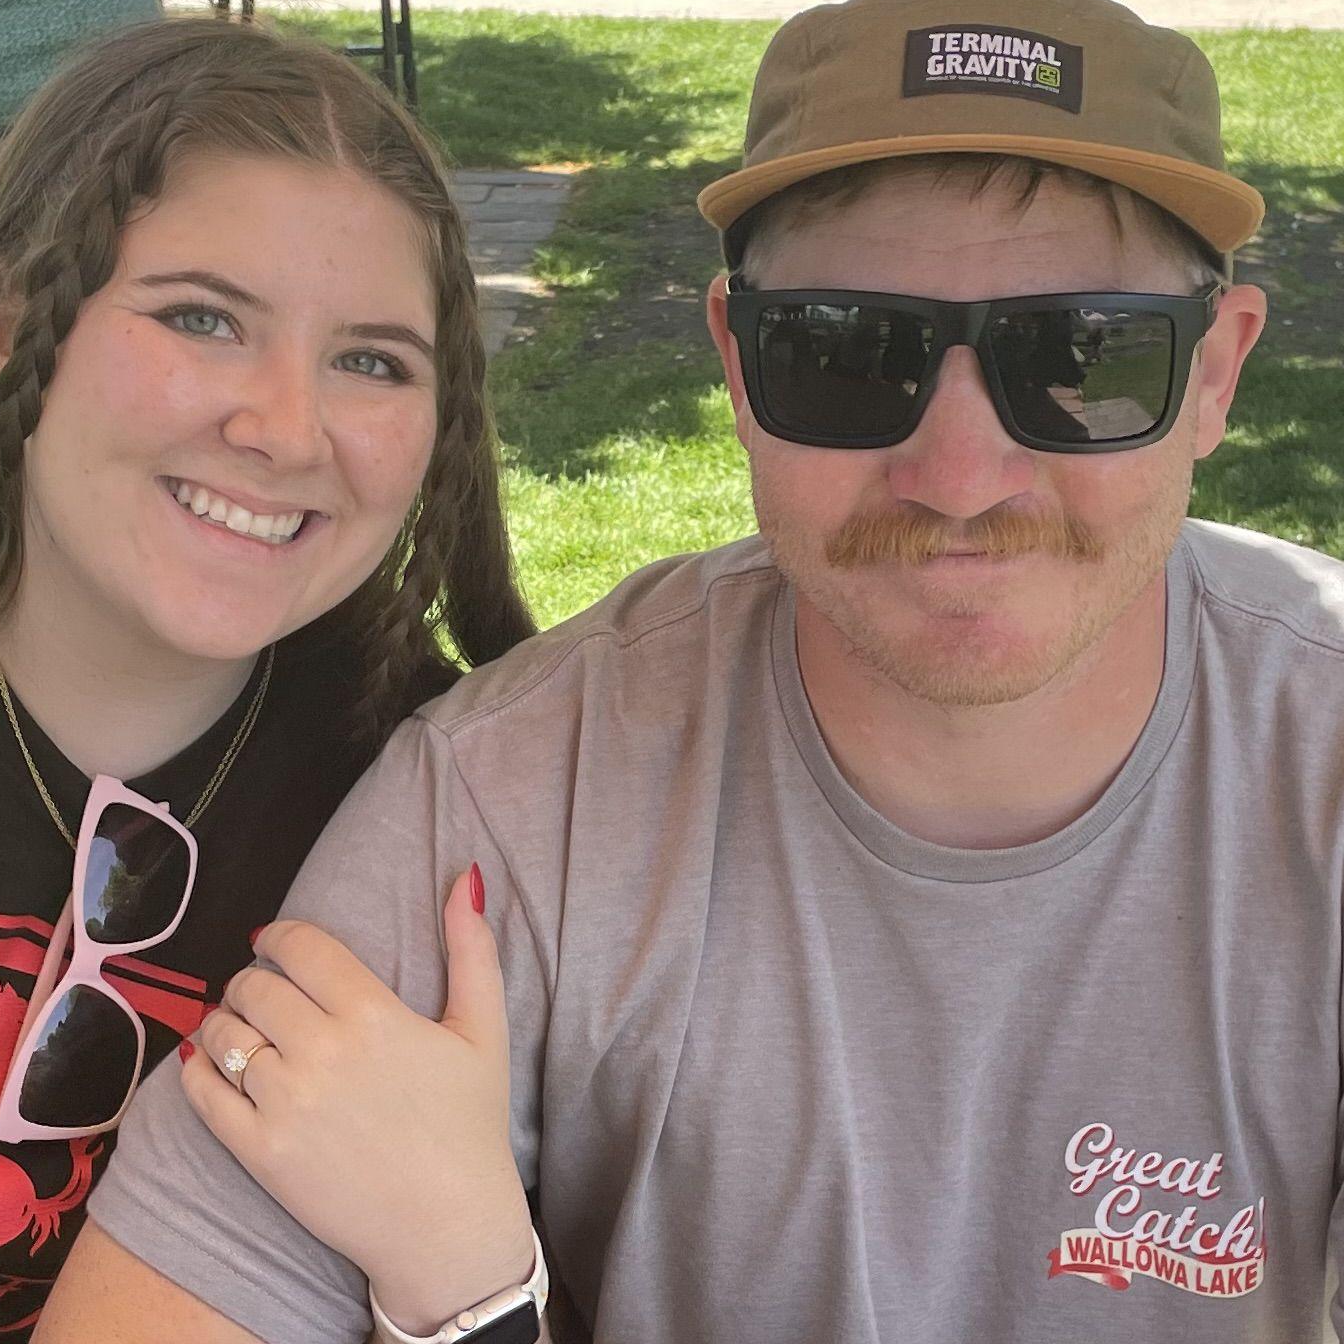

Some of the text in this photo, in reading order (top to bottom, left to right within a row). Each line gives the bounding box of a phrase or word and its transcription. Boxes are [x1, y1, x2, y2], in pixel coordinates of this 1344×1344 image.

[926, 54, 1036, 81] GRAVITY
[928, 32, 1061, 66] TERMINAL
[1064, 1122, 1223, 1198] Great
[1066, 1236, 1258, 1295] WALLOWA LAKE
